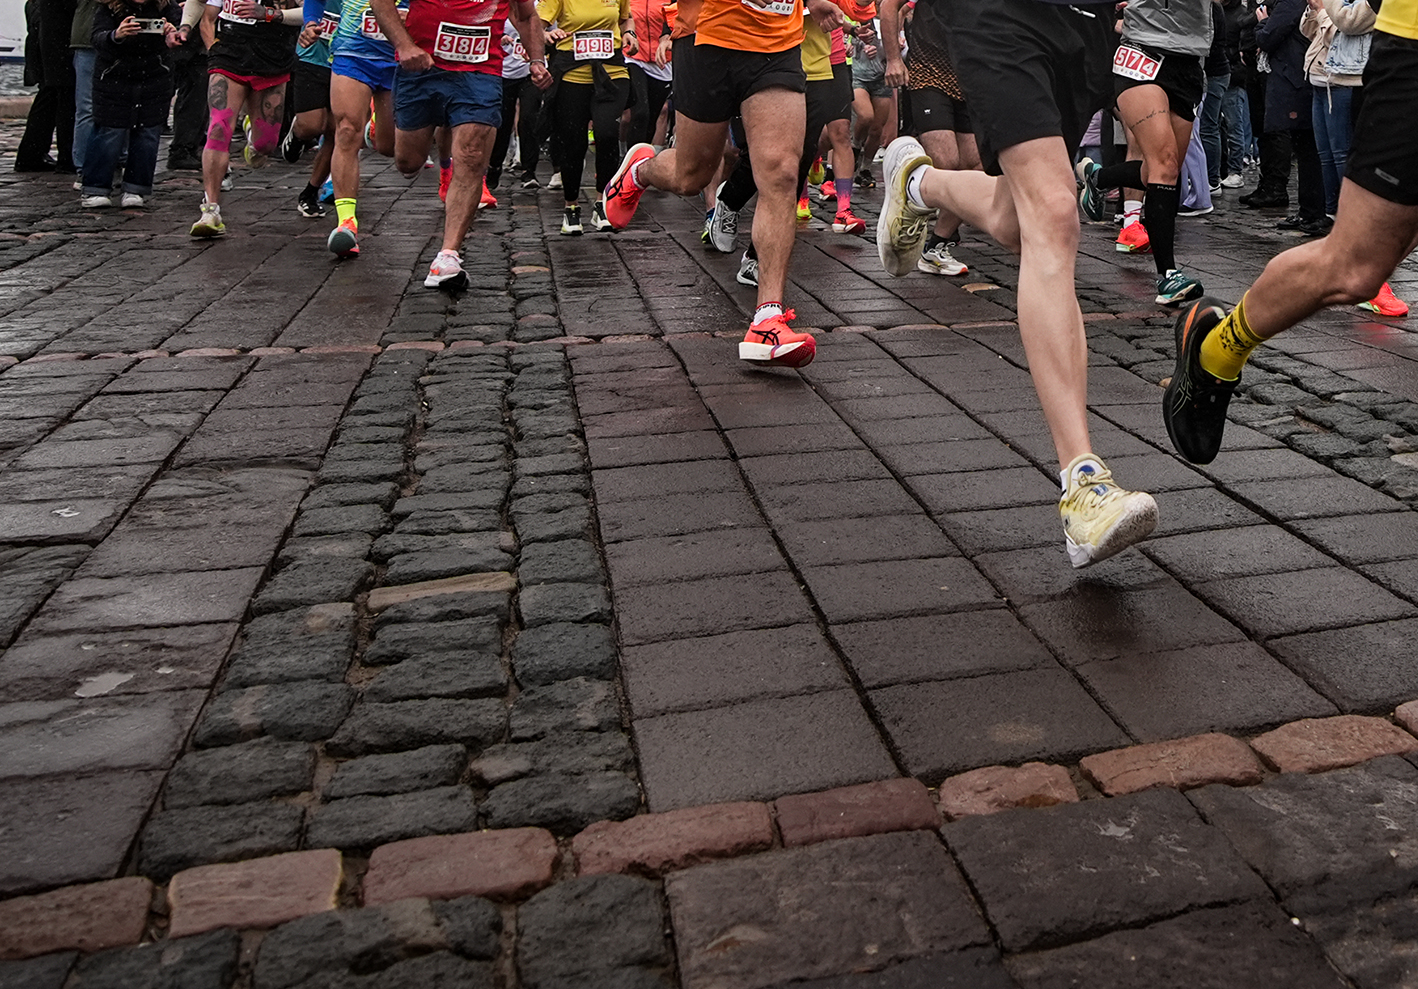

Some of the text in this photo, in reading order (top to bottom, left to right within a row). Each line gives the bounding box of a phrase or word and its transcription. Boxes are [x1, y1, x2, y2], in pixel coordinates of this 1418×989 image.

[440, 35, 486, 54] 384
[577, 38, 611, 53] 498
[1115, 48, 1157, 77] 574
